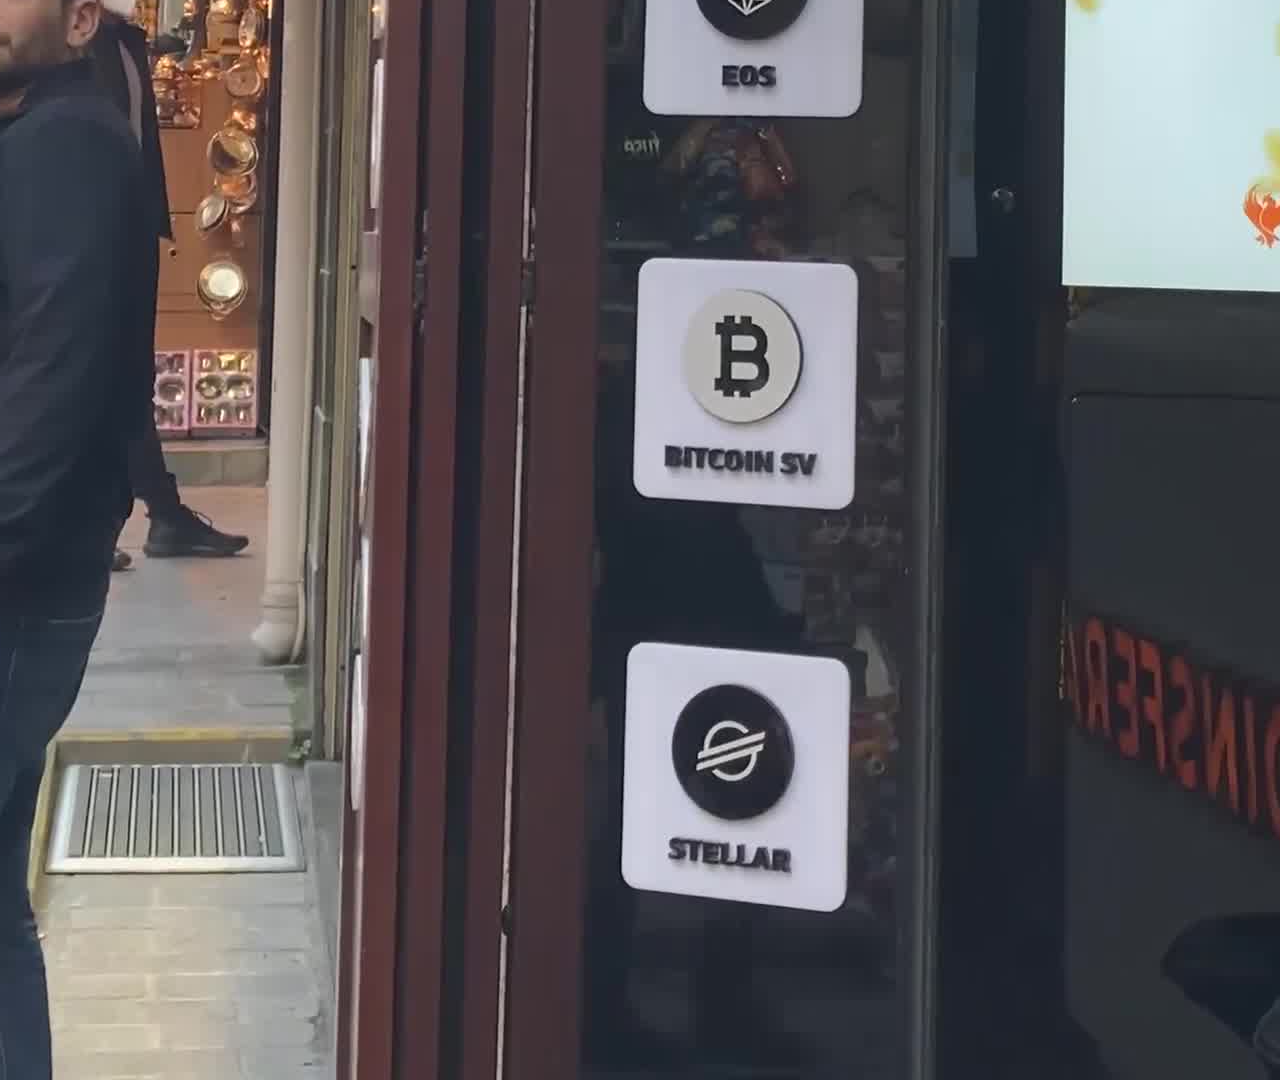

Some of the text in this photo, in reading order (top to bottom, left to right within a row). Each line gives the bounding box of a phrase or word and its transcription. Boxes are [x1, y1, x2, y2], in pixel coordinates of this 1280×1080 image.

[722, 65, 777, 88] EOS
[664, 445, 818, 477] BITCOIN SV
[668, 837, 792, 873] STELLAR
